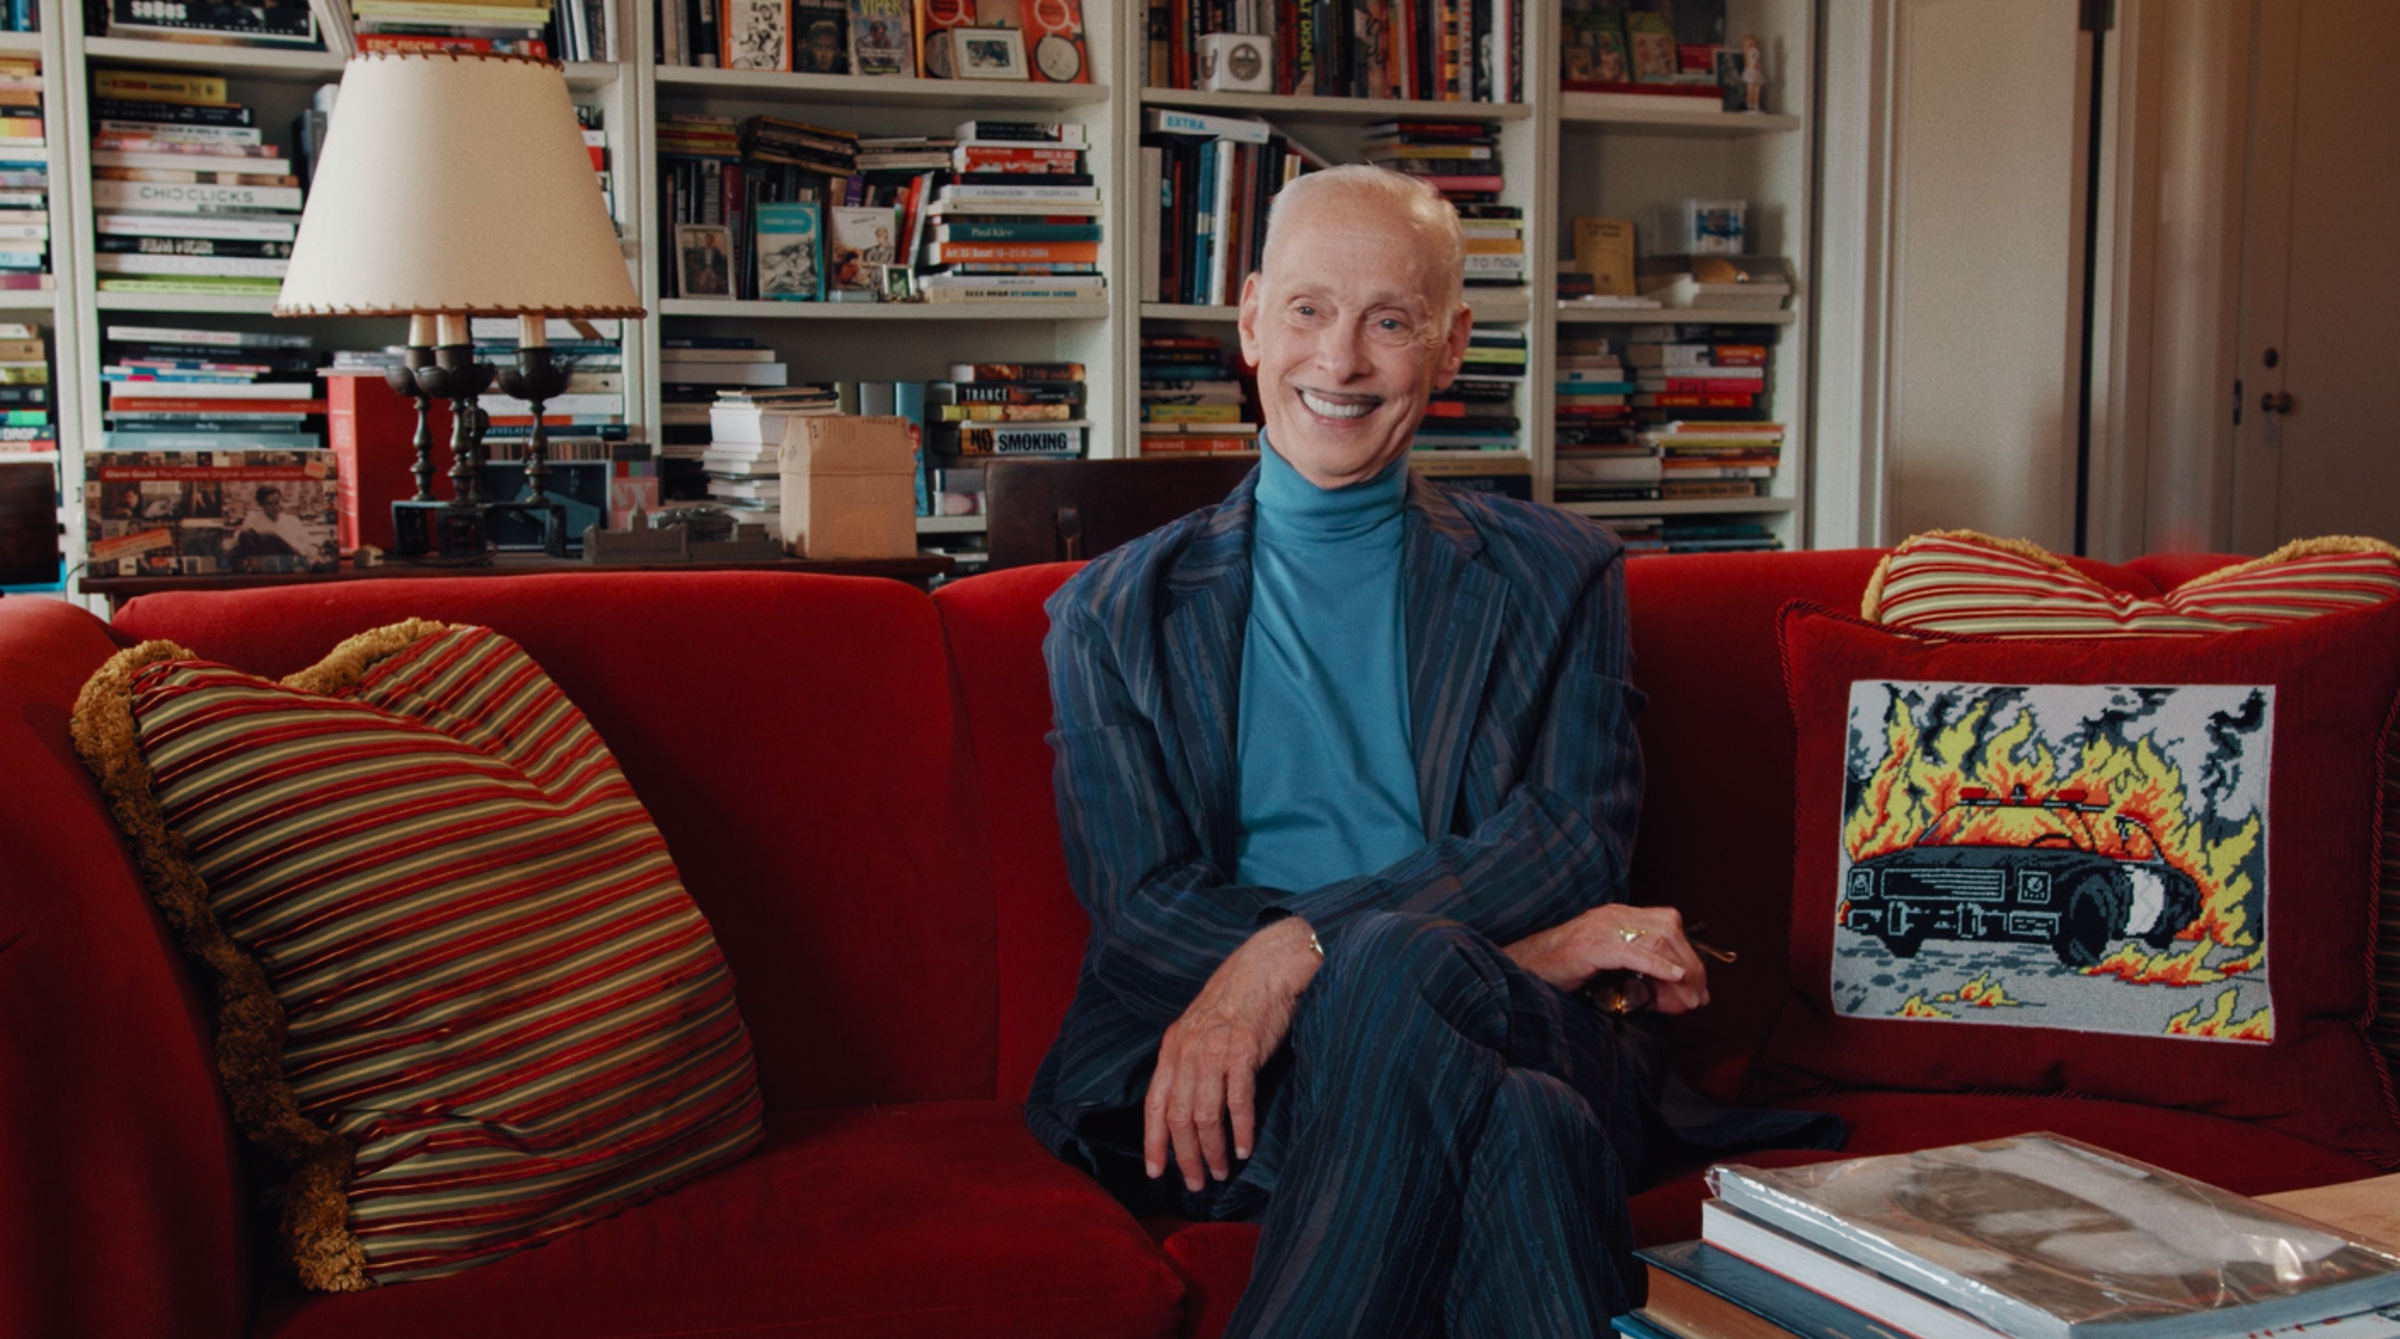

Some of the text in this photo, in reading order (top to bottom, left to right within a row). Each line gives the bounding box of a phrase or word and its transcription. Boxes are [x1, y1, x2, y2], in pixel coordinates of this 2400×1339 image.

[366, 39, 395, 50] ERIC
[1299, 19, 1314, 74] DISNEY
[1166, 115, 1206, 130] EXTRA
[187, 188, 254, 203] CLICKS
[971, 228, 991, 237] Paul
[945, 248, 957, 258] Art
[965, 388, 1008, 401] TRANCE
[2, 427, 38, 441] DROP
[970, 428, 1068, 452] NO SMOKING
[105, 469, 303, 480] Glenn Gould The Complete Original Jacket Collection
